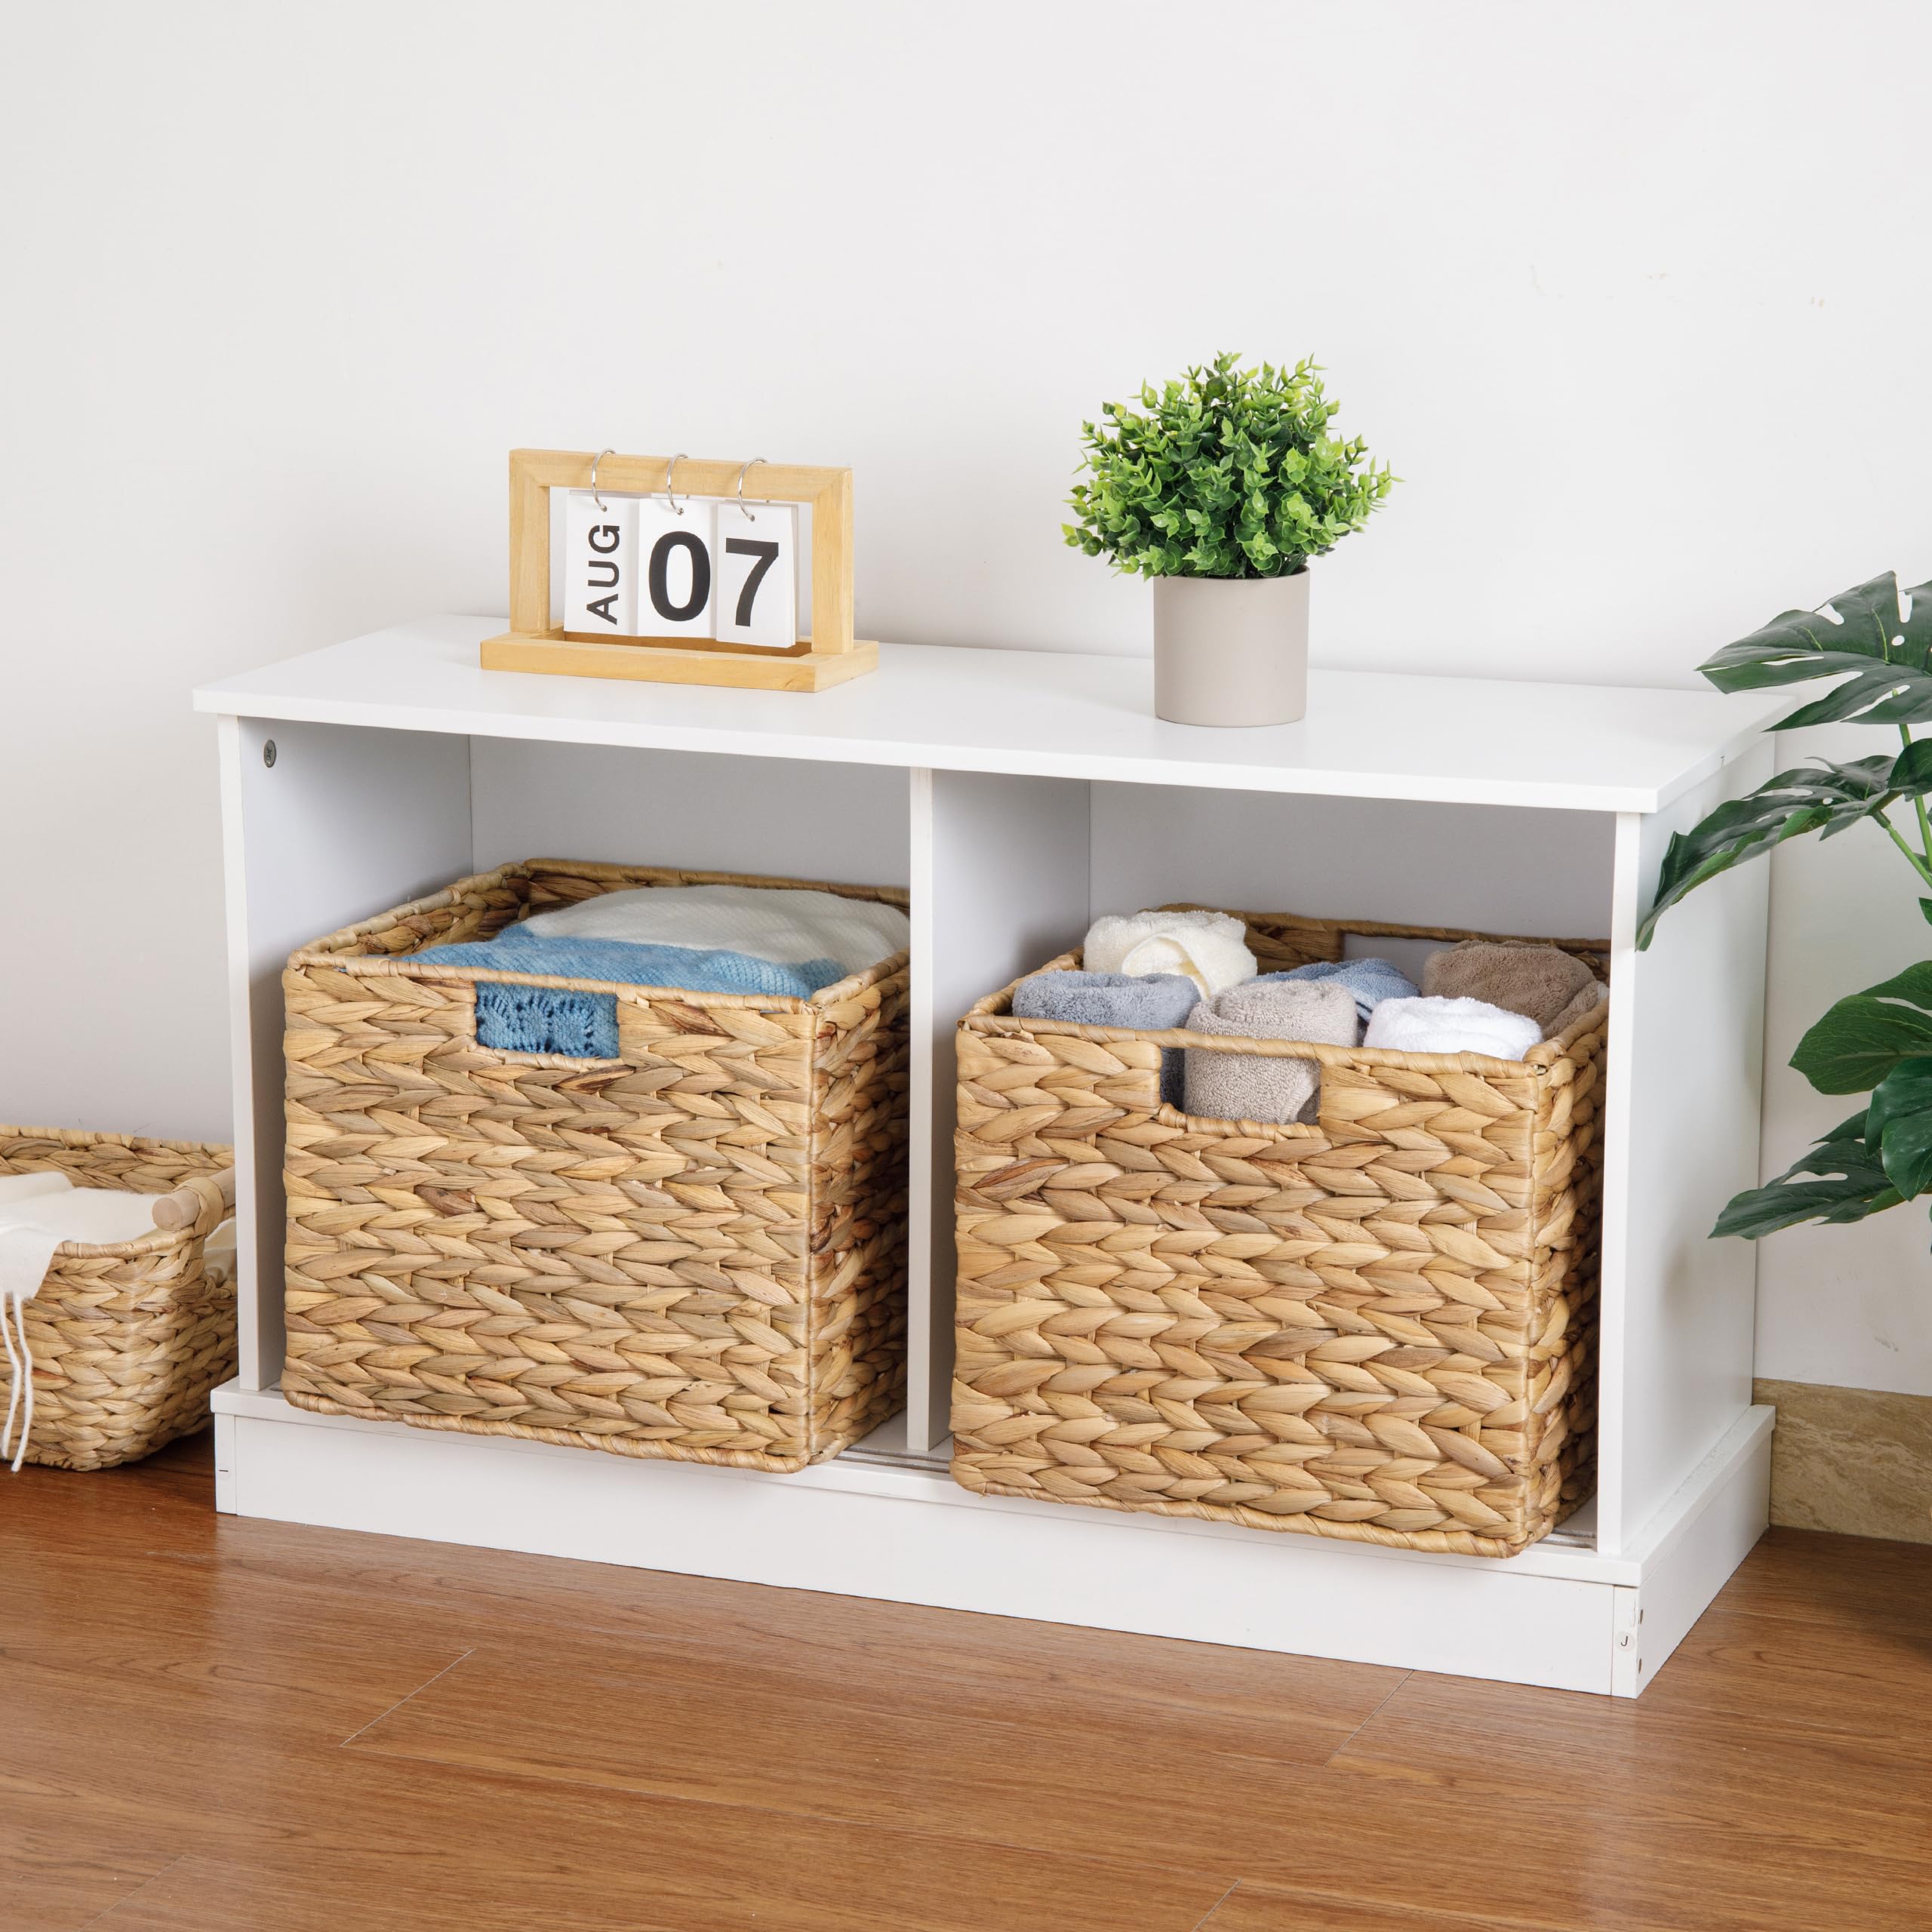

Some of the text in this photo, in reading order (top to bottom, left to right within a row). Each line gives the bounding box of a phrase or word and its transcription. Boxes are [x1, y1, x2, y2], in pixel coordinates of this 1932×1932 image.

[587, 525, 620, 625] AUG
[648, 531, 780, 627] 07
[1620, 1635, 1629, 1647] J
